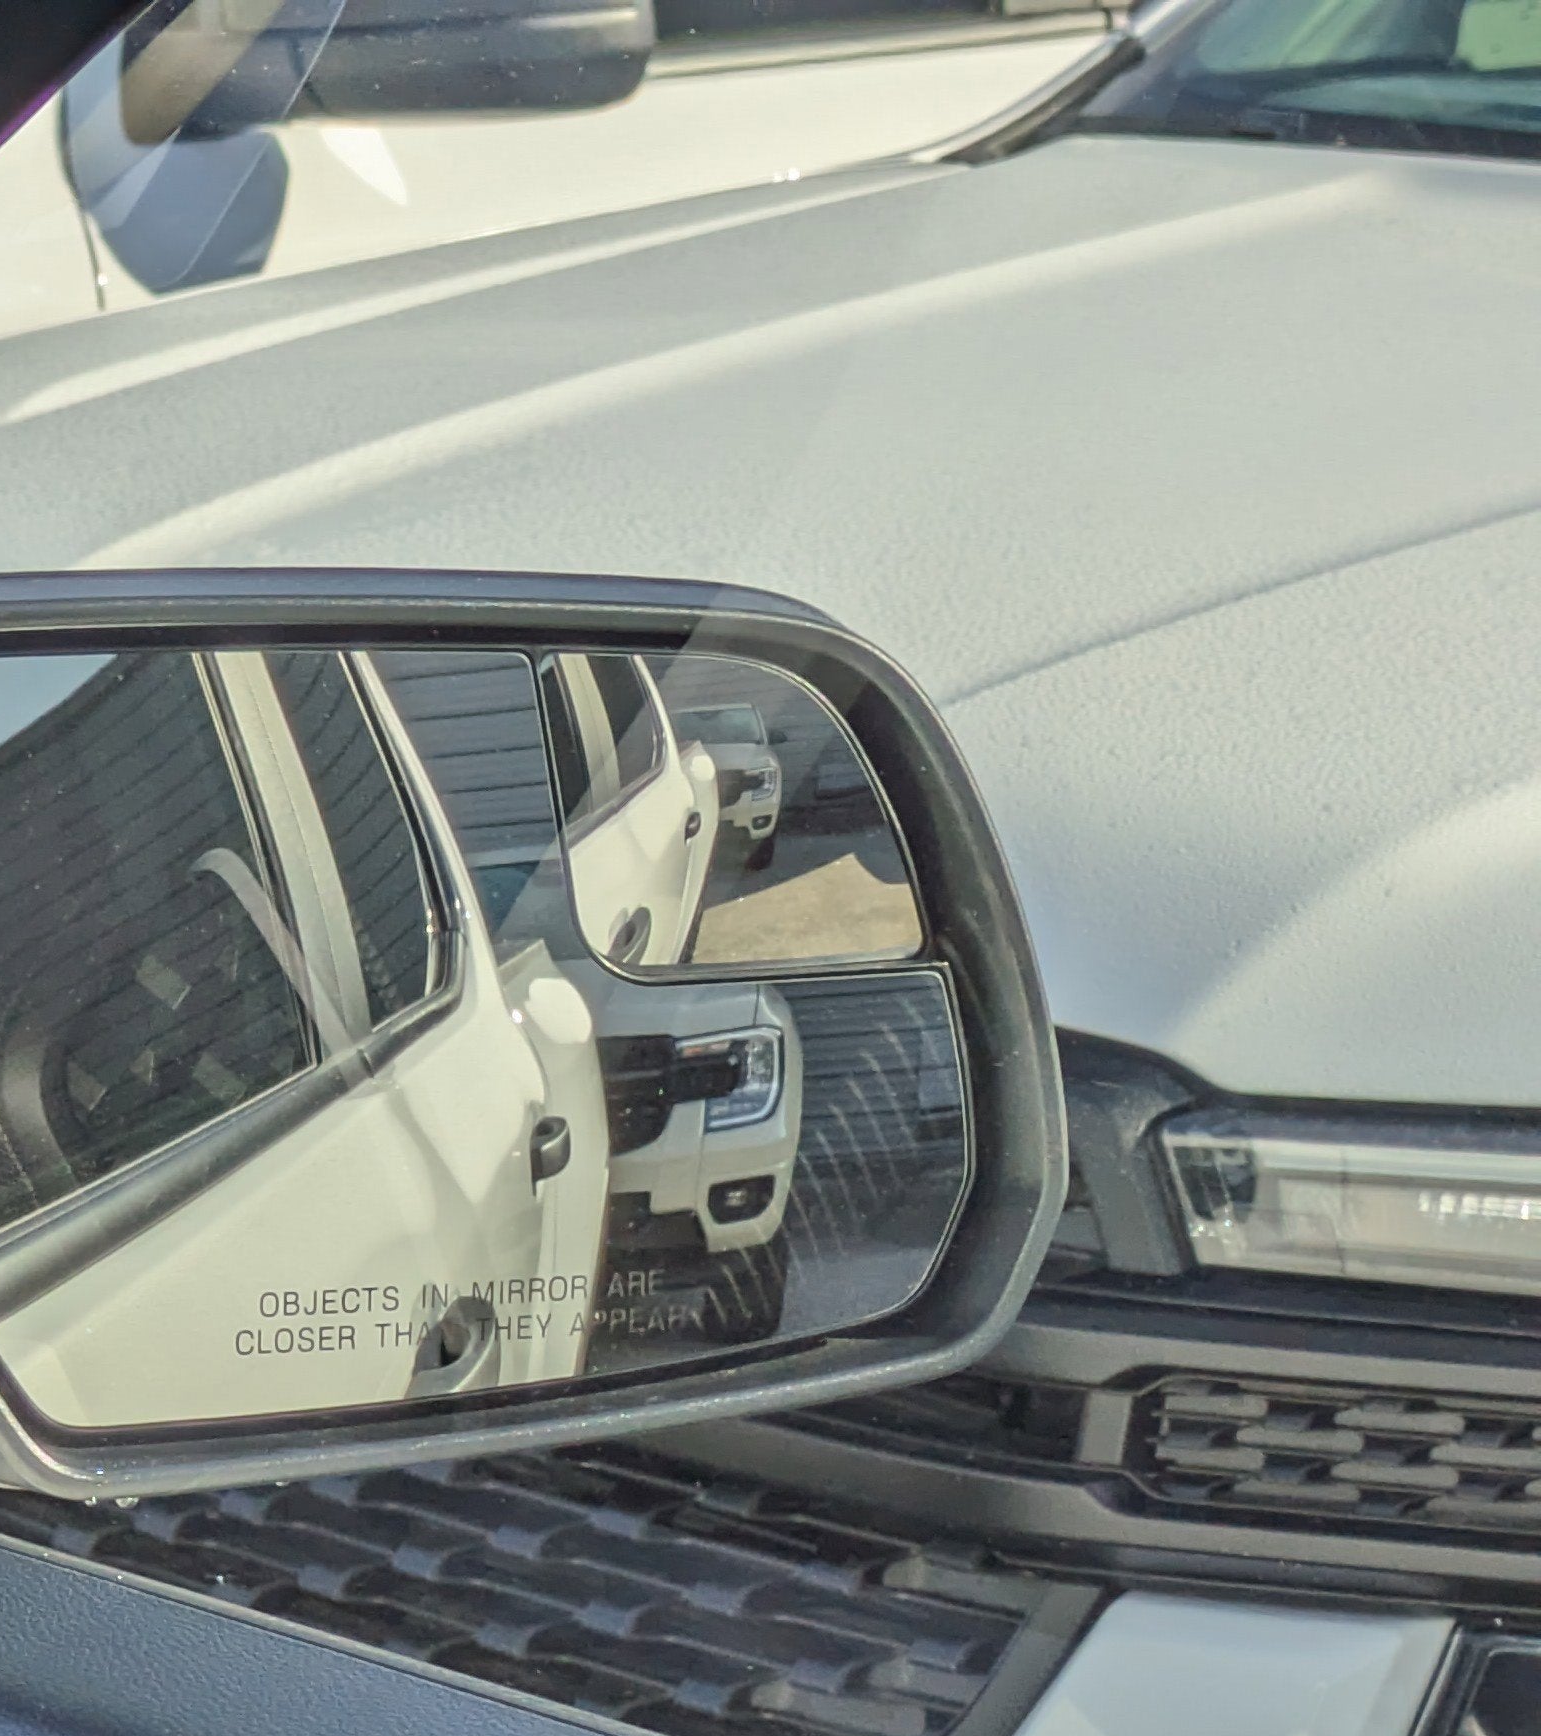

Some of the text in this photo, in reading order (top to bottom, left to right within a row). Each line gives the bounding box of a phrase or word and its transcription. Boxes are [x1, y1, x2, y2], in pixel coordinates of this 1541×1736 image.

[259, 1270, 664, 1318] OBJECTS IN MIRROR ARE
[235, 1324, 357, 1357] CLOSER
[476, 1314, 552, 1342] THEY
